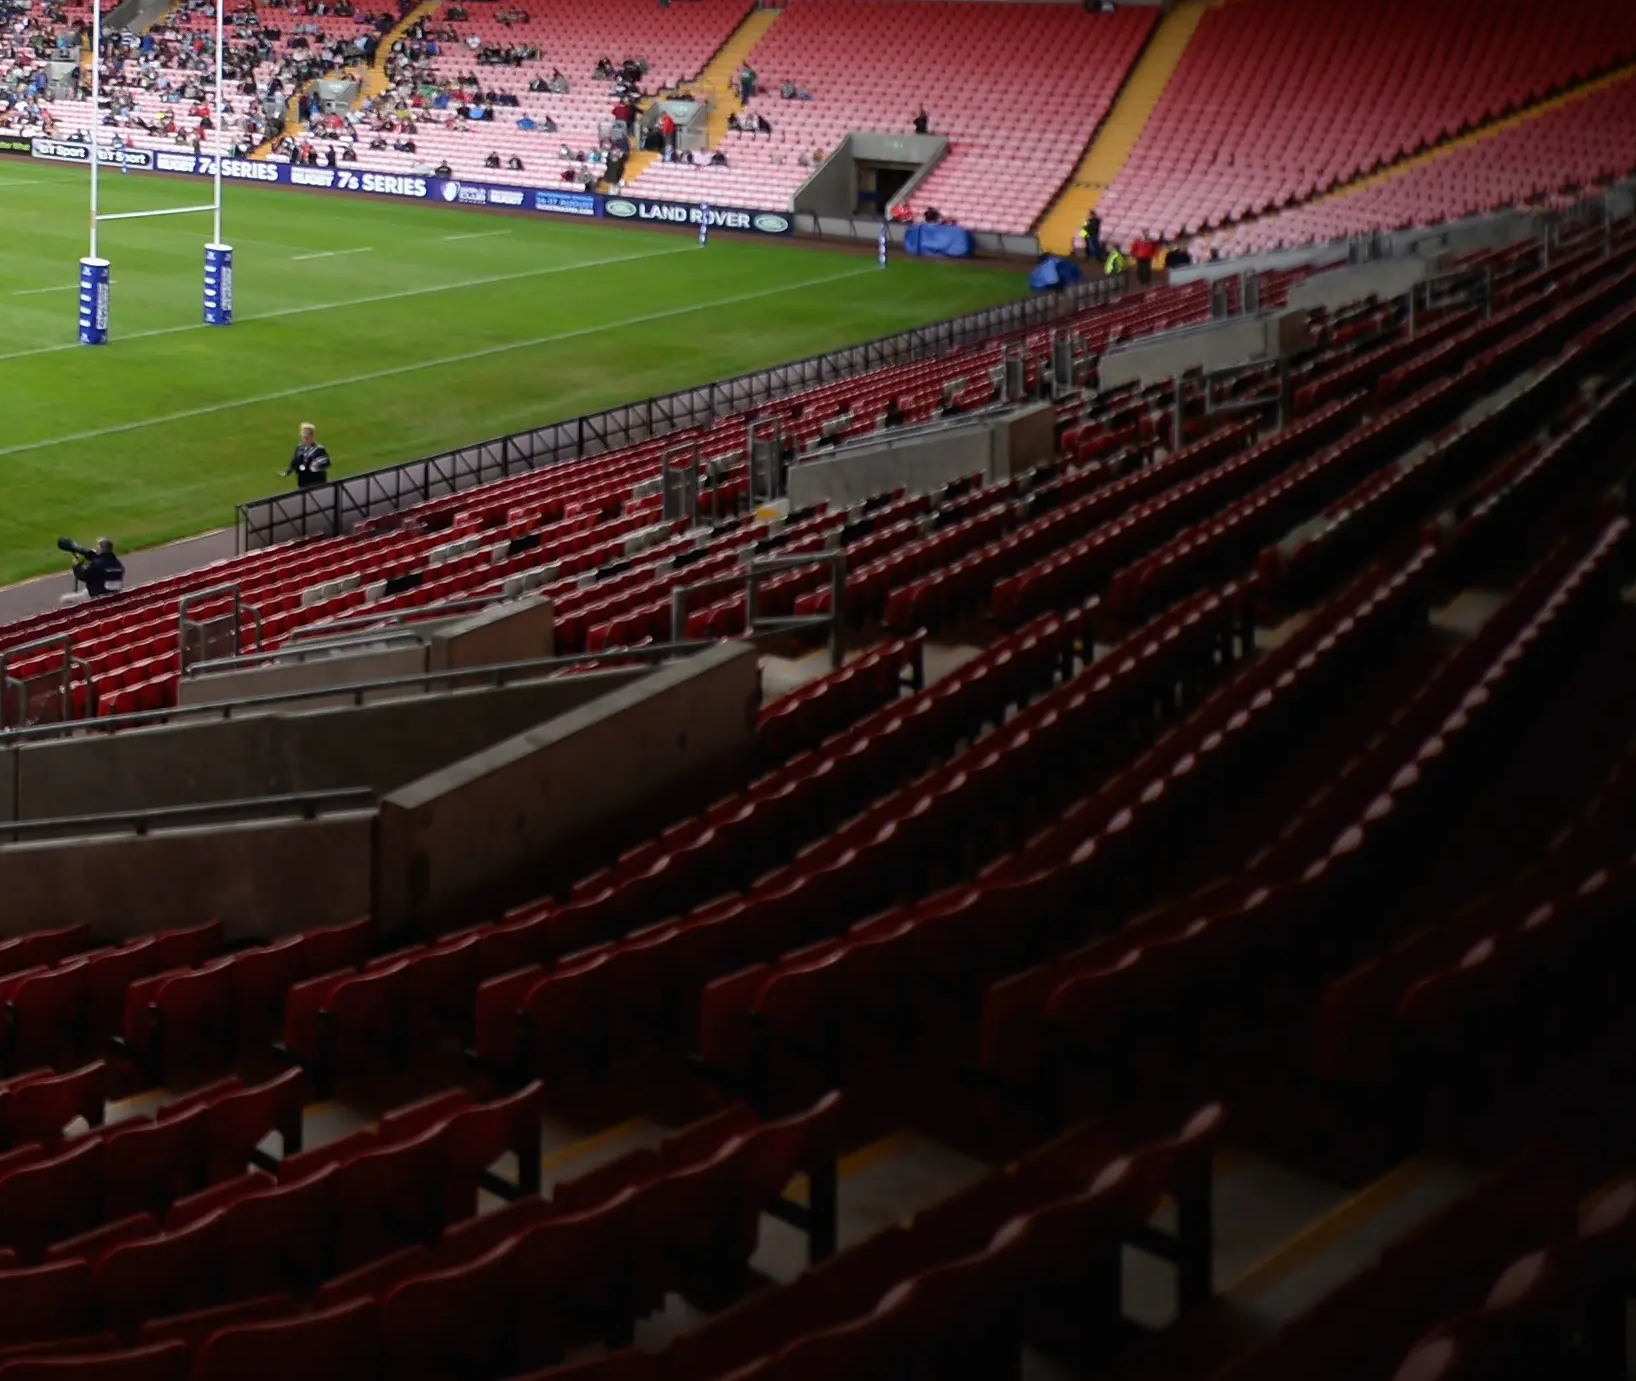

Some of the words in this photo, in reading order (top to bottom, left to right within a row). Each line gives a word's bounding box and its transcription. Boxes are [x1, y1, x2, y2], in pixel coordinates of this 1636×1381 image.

[57, 144, 86, 158] Sport
[221, 159, 279, 181] SERIES
[337, 171, 360, 190] 7s
[362, 174, 427, 197] SERIES
[638, 203, 687, 222] LAND
[689, 208, 751, 228] ROVER
